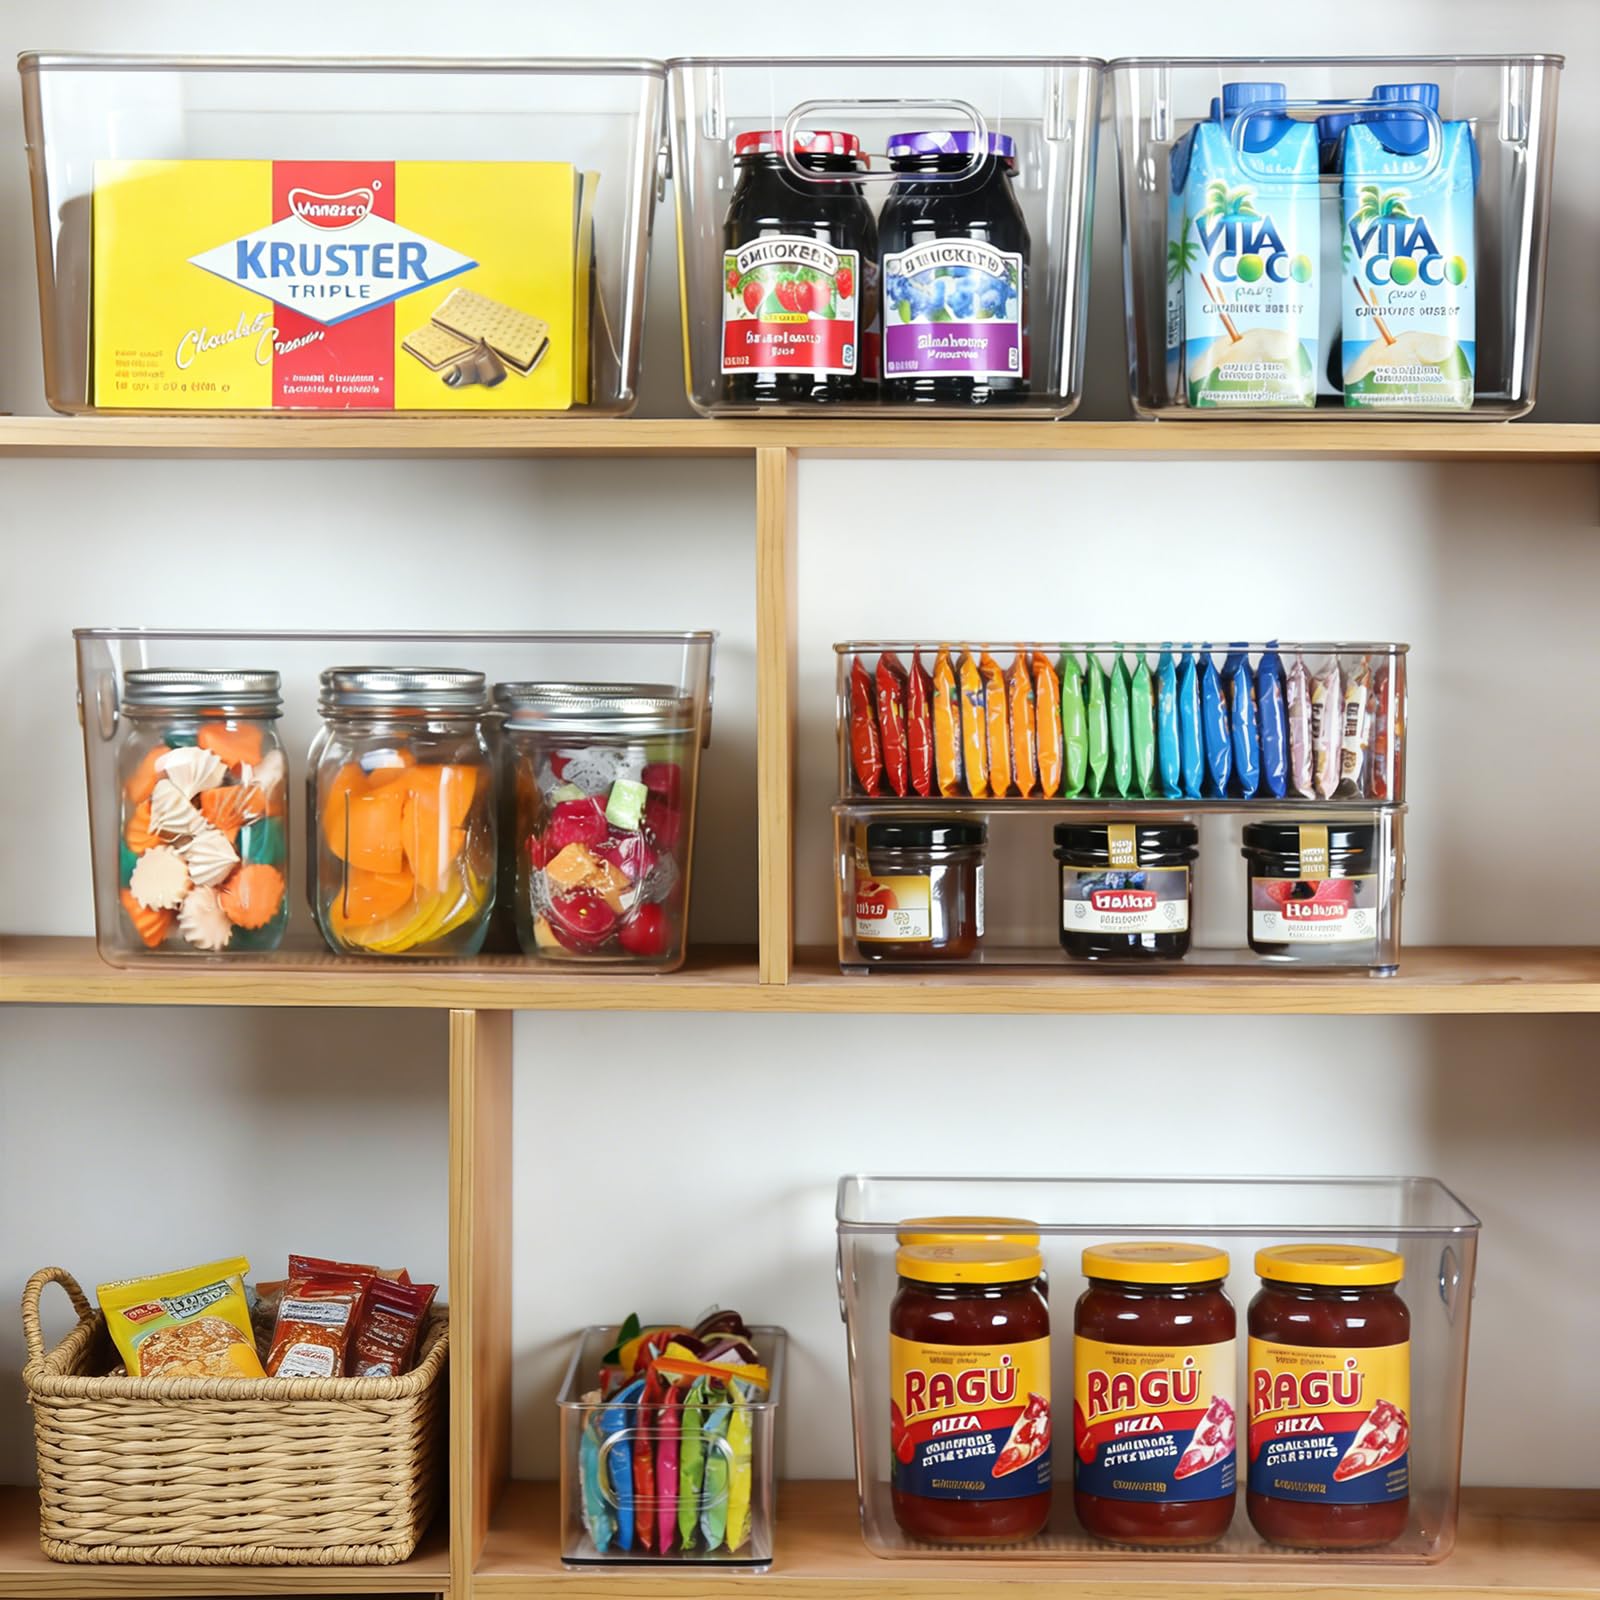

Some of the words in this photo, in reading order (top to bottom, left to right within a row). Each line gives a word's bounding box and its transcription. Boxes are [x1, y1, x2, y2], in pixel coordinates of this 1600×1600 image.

[1196, 214, 1287, 256] VITA
[1348, 216, 1440, 259] VITA
[236, 239, 430, 281] KRUSTER
[1213, 250, 1313, 283] COCO
[1365, 254, 1468, 286] COCO
[288, 284, 371, 299] TRIPLE
[932, 1415, 982, 1436] PIZZA
